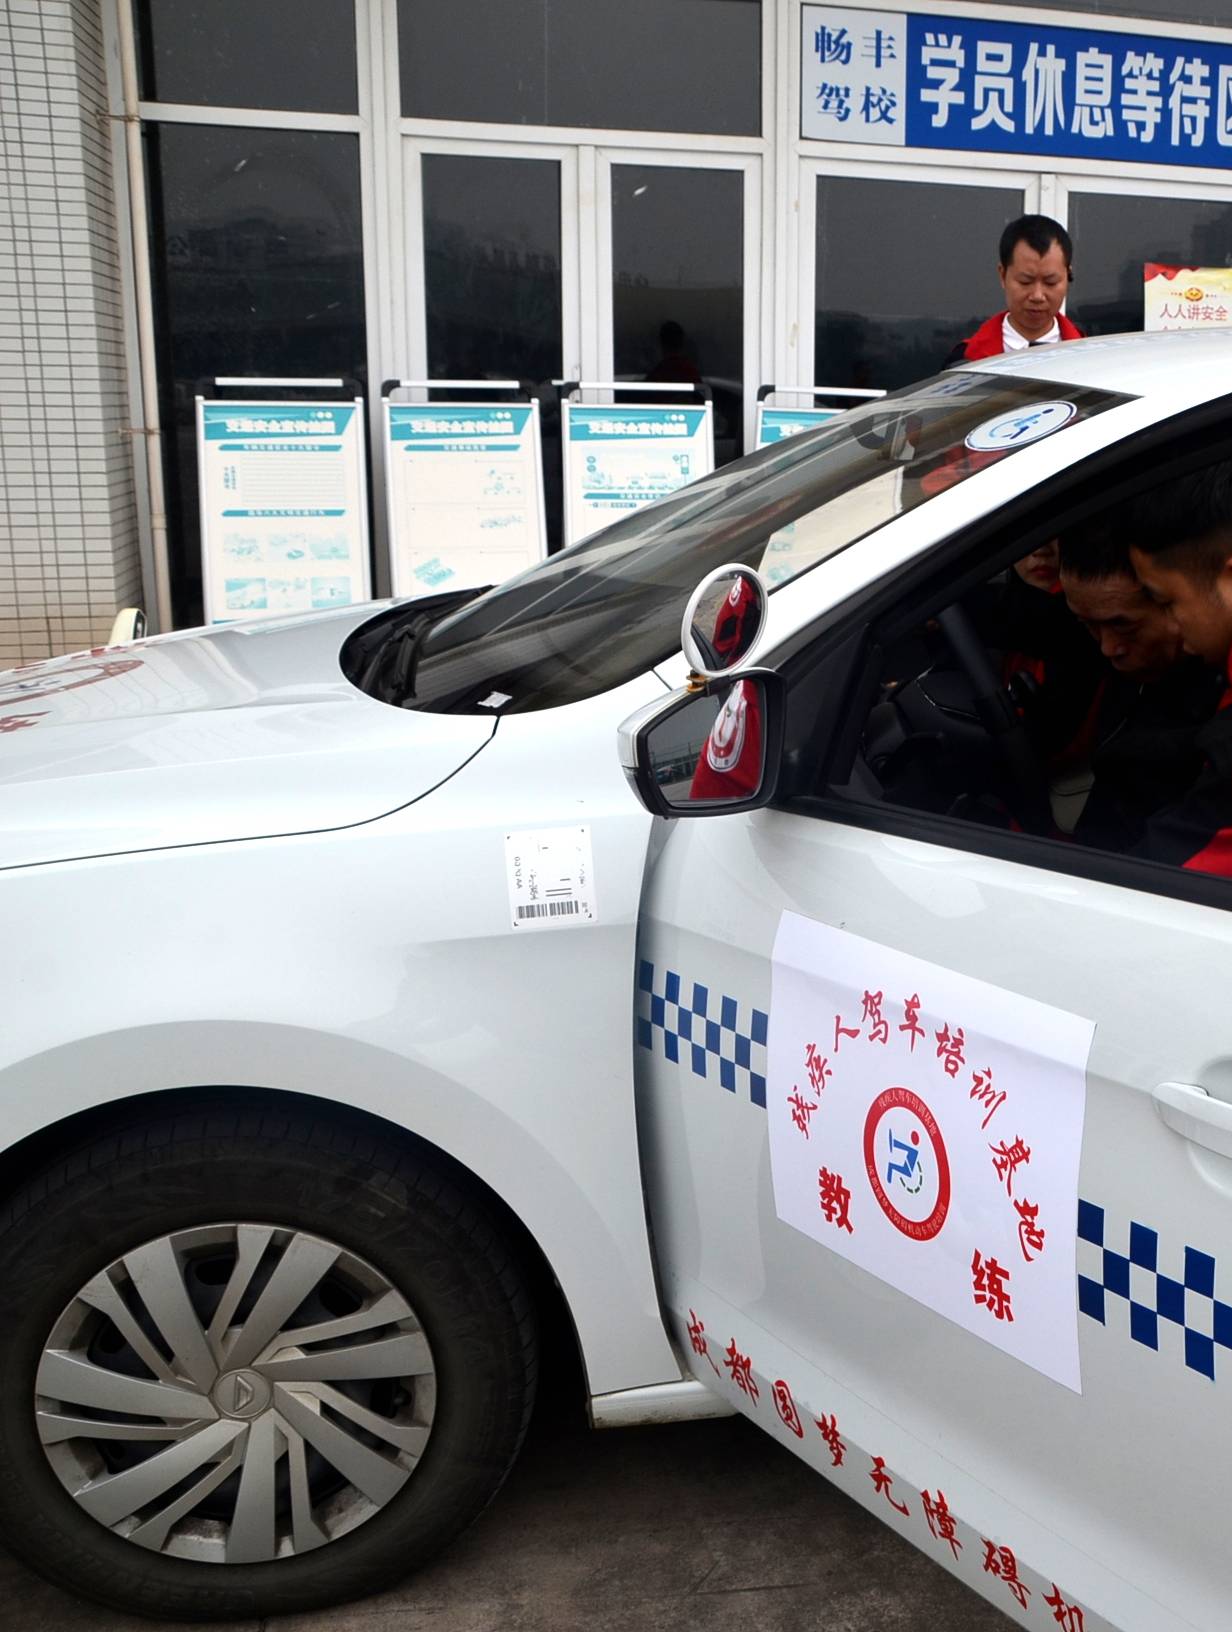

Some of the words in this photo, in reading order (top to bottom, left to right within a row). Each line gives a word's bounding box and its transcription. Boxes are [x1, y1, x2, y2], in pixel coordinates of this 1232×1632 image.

[814, 25, 897, 68] 畅丰
[815, 82, 898, 125] 驾校
[1160, 303, 1229, 321] 人人讲安全
